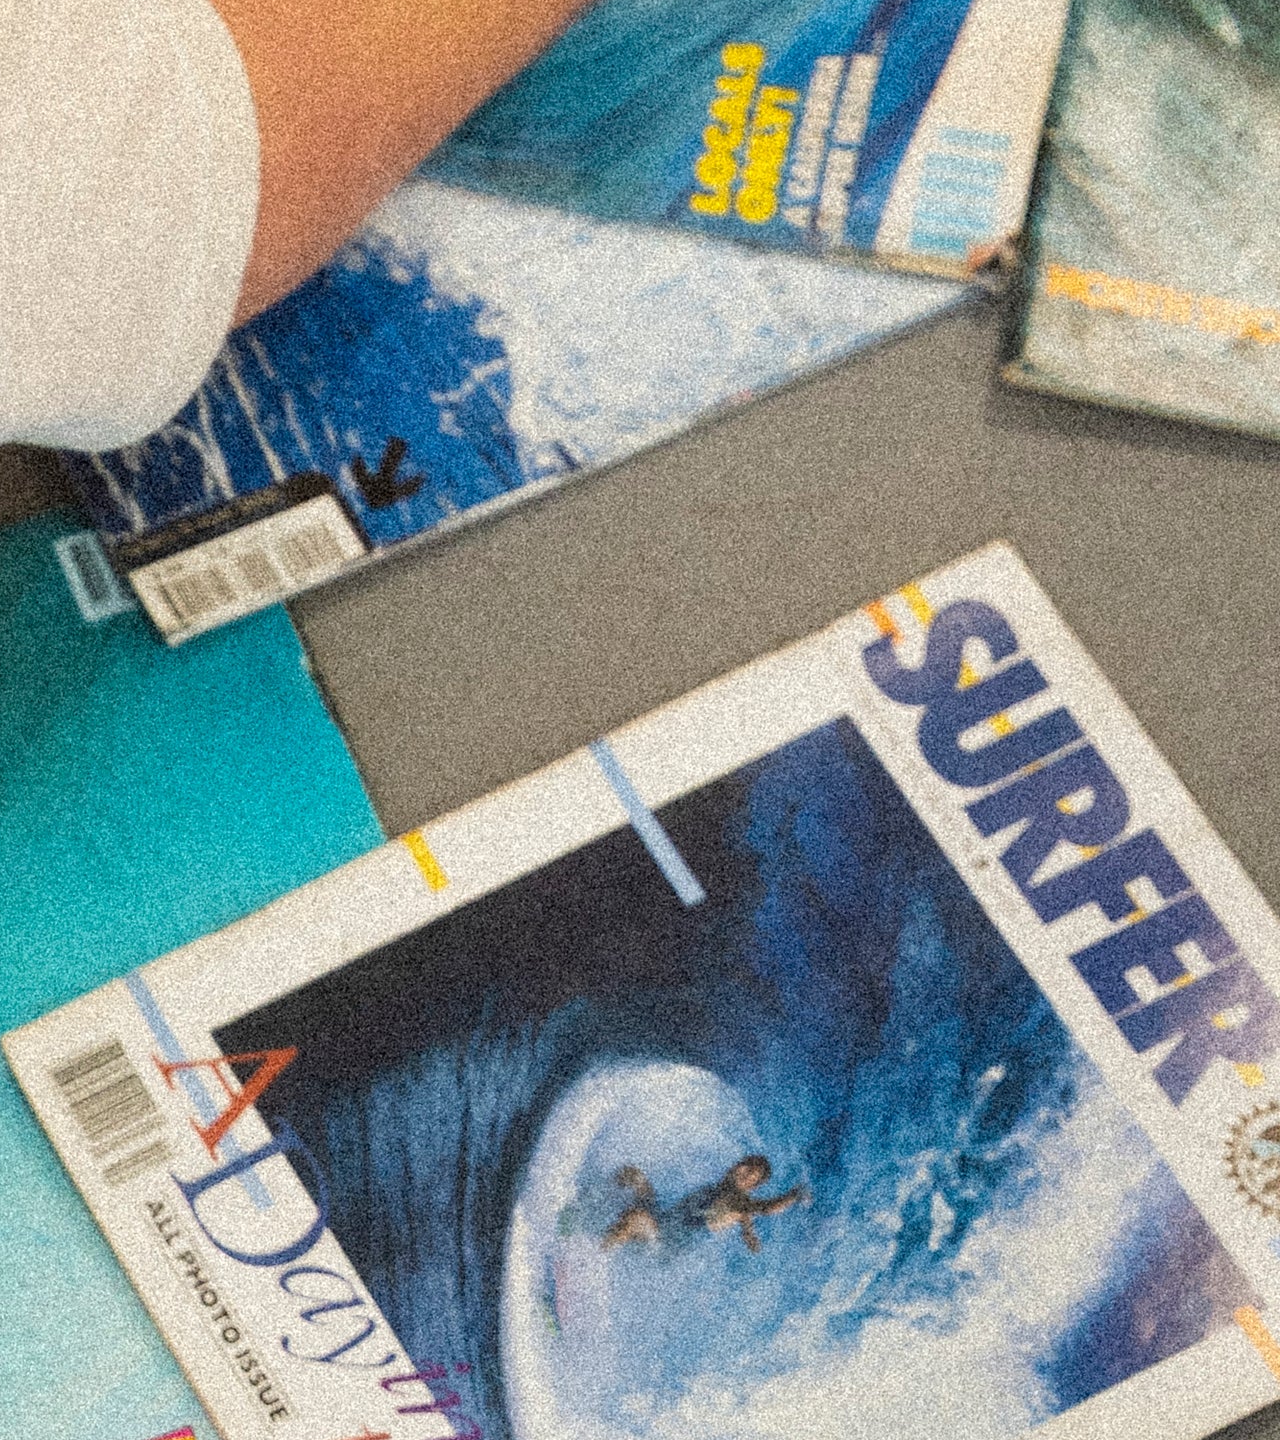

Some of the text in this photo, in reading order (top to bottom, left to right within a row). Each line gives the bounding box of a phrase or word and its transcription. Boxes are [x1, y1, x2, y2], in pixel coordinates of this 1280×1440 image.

[861, 597, 1280, 1109] SURFER
[144, 1197, 290, 1424] ALL PHOTO ISSUE
[149, 1043, 397, 1371] A Day
